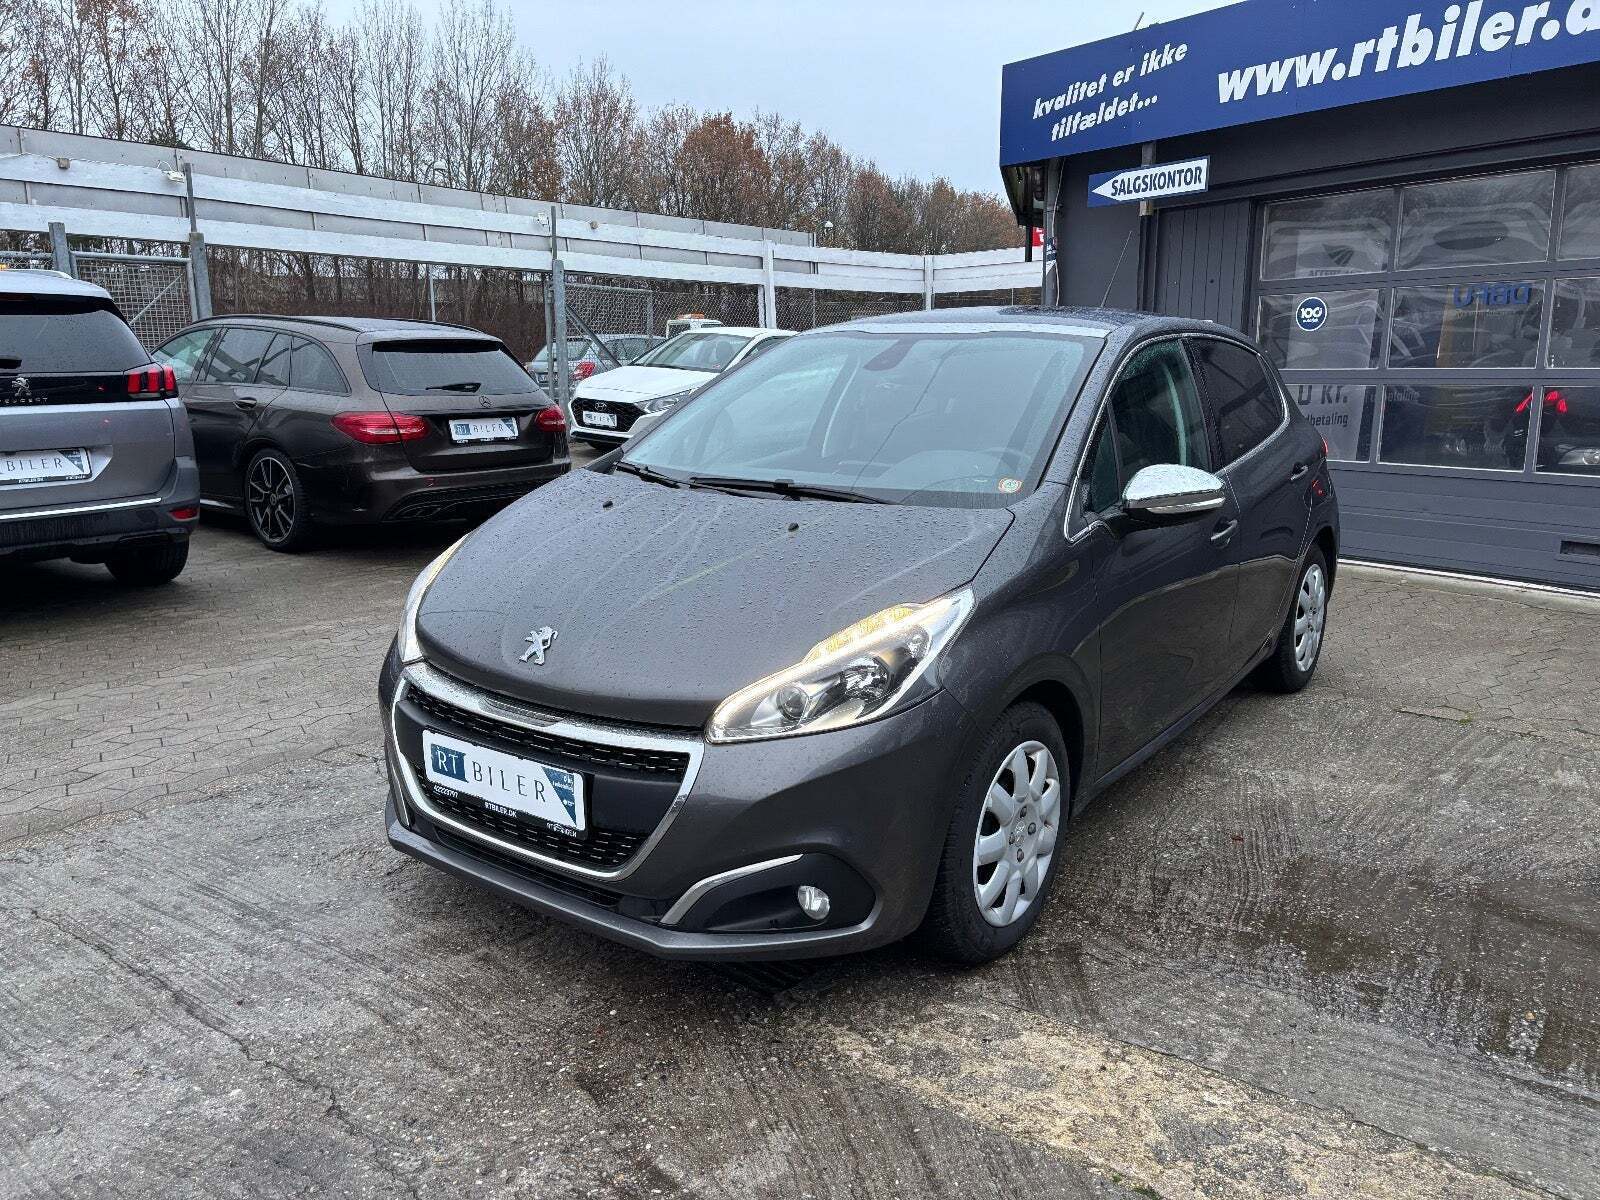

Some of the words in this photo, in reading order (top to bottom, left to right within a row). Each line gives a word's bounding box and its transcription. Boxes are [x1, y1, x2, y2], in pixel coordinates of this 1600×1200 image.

[1033, 73, 1107, 119] kvalitet
[1112, 64, 1135, 87] er
[1139, 43, 1188, 77] ikke
[1051, 92, 1158, 141] tilfældet...
[1111, 166, 1203, 197] SALGSKONTOR
[6, 457, 63, 471] BILER
[435, 747, 459, 775] RT
[471, 760, 546, 803] BILER
